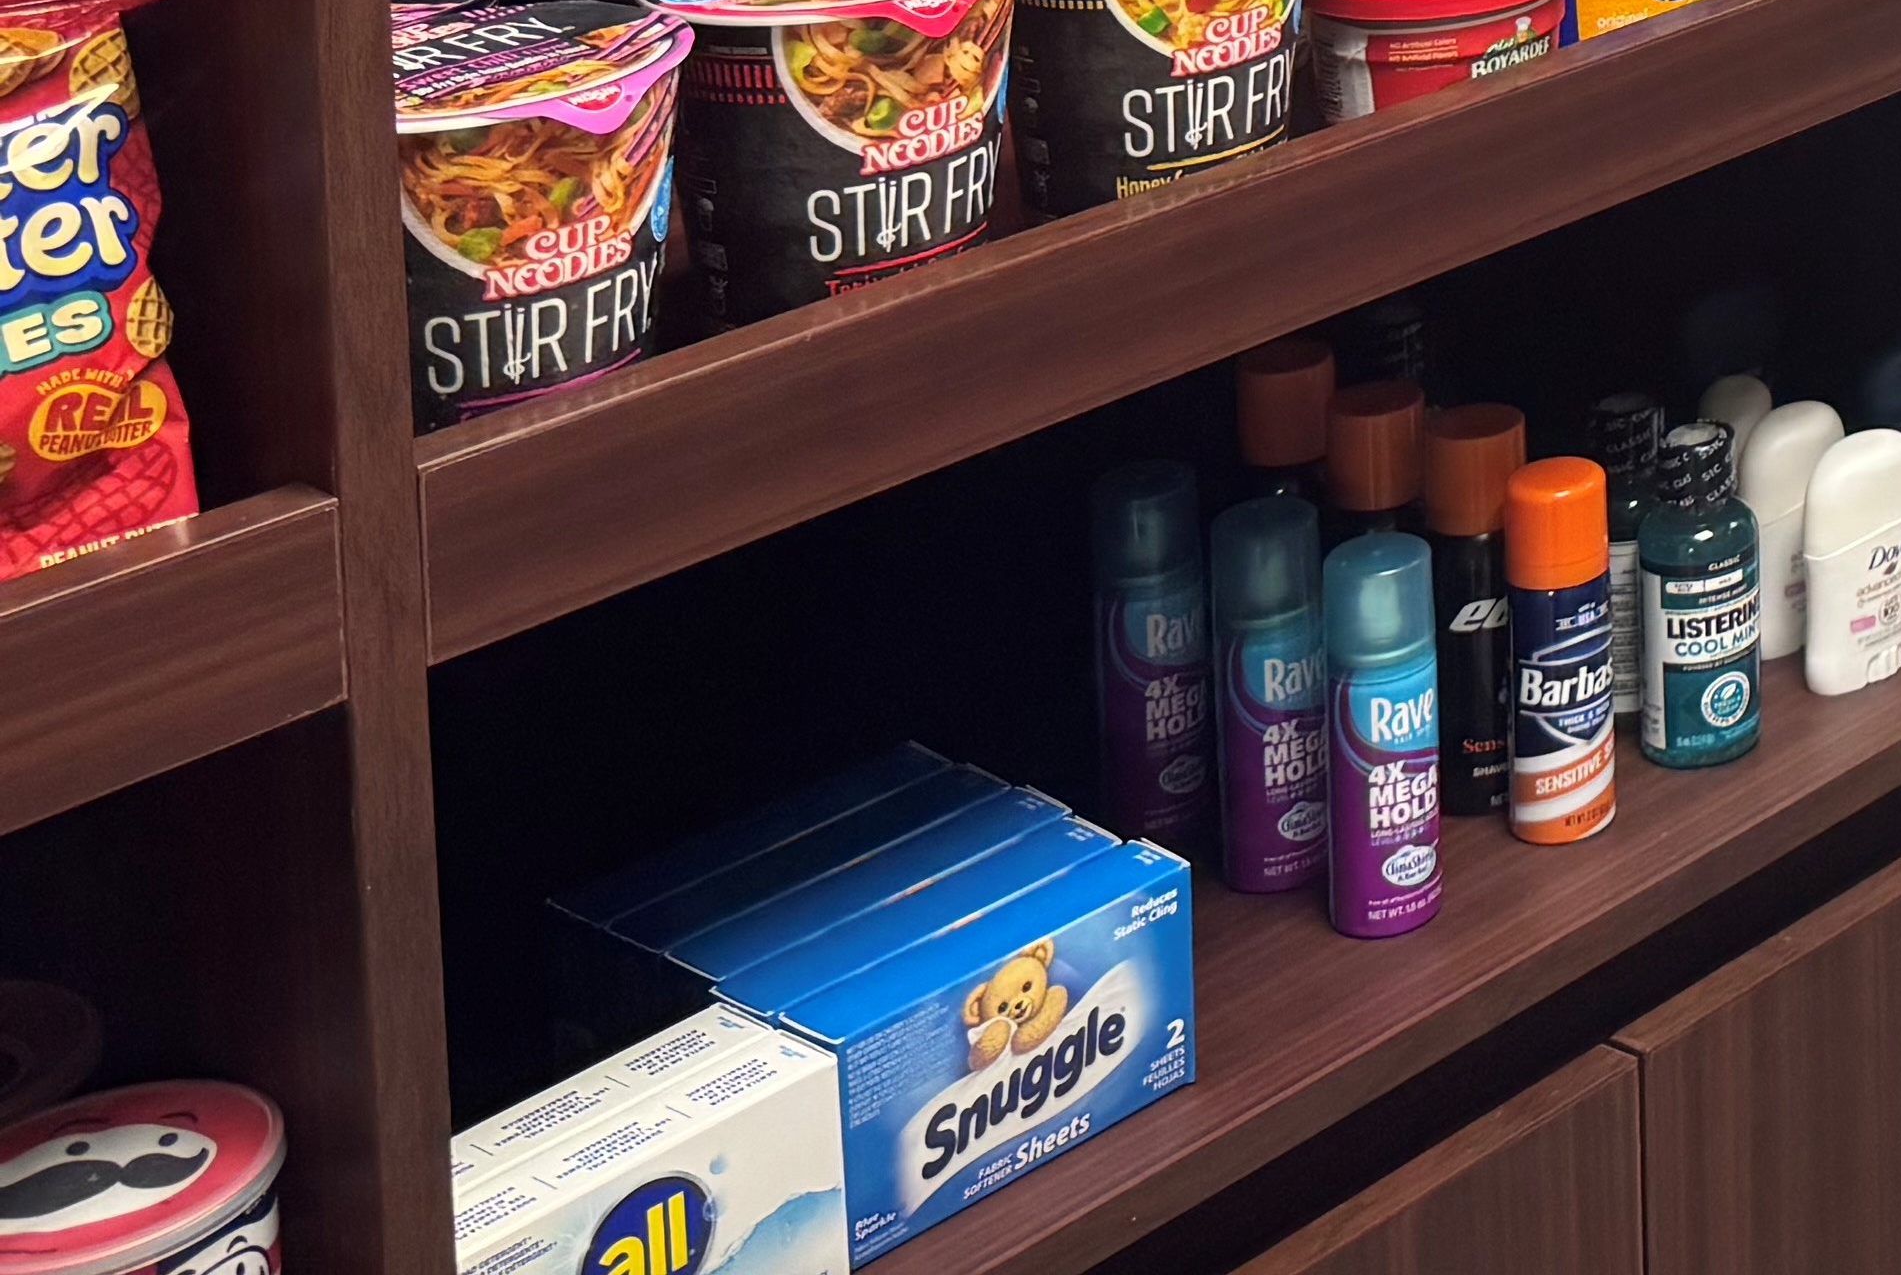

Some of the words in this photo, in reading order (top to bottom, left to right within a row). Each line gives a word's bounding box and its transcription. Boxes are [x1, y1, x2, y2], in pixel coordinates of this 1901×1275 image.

[900, 96, 969, 135] CUP
[861, 111, 984, 175] NOODLES
[944, 131, 1001, 234] FRY
[525, 214, 612, 253] CUP
[483, 233, 633, 300] NOODLES
[585, 257, 657, 364] FRY
[1675, 636, 1728, 658] COOL
[1370, 695, 1435, 745] Rave
[1368, 759, 1405, 786] 4X
[1368, 768, 1438, 809] MEGA
[1535, 755, 1602, 795] SENSITIVE
[1368, 793, 1438, 831] HOLD
[1113, 913, 1148, 941] Static
[1149, 900, 1178, 925] Cling
[1132, 888, 1178, 917] Reduces
[1166, 1018, 1185, 1046] 2
[1149, 1046, 1187, 1072] SHEETS
[921, 1004, 1126, 1183] Snuggle
[1014, 1110, 1092, 1172] Sheets
[962, 1168, 1014, 1200] SOFTENER
[978, 1151, 1014, 1180] FABRIC
